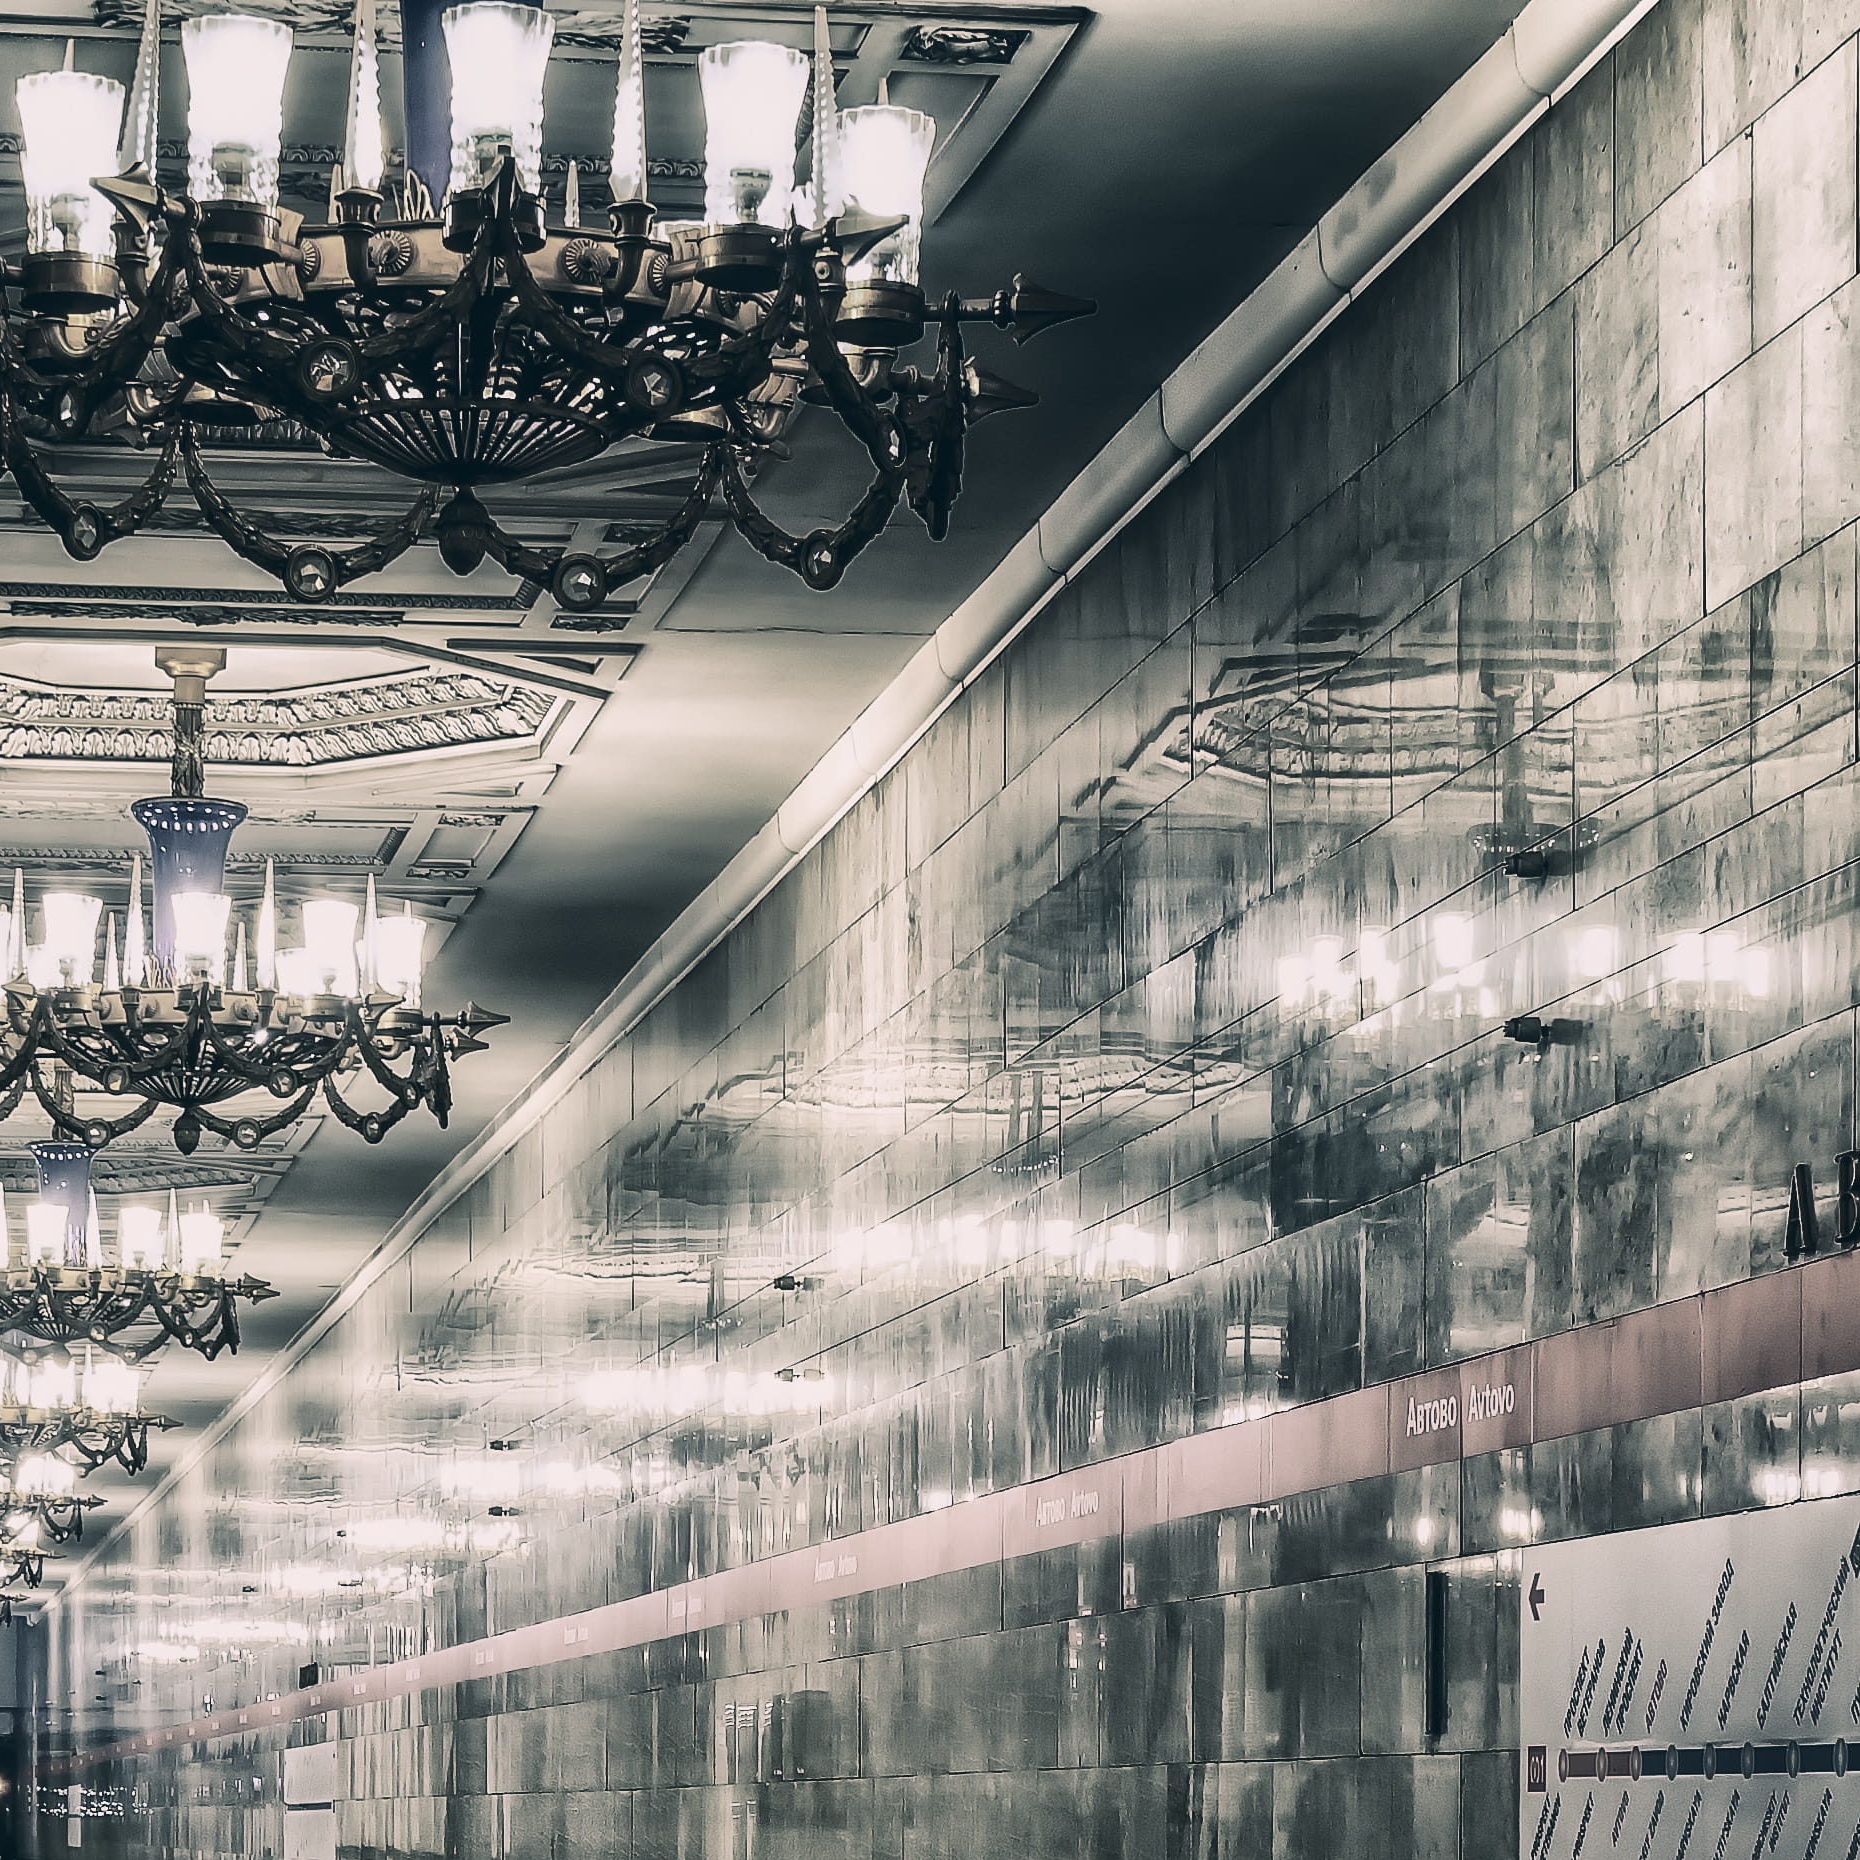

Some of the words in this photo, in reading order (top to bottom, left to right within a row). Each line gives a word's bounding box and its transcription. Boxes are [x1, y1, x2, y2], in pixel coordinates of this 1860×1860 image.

[1405, 1396, 1458, 1438] Автово
[1467, 1383, 1516, 1423] Avtovo
[1679, 1619, 1715, 1732] КИРОВСКИЙ
[1712, 1558, 1734, 1625] ЗАВОД
[1717, 1629, 1750, 1731] НАРВСКАЯ
[1757, 1602, 1797, 1730] БАЛТИЙСКАЯ
[1793, 1555, 1850, 1726] ТЕХНОЛОГИЧЕСКИЙ
[1645, 1659, 1668, 1734] АВТОВО
